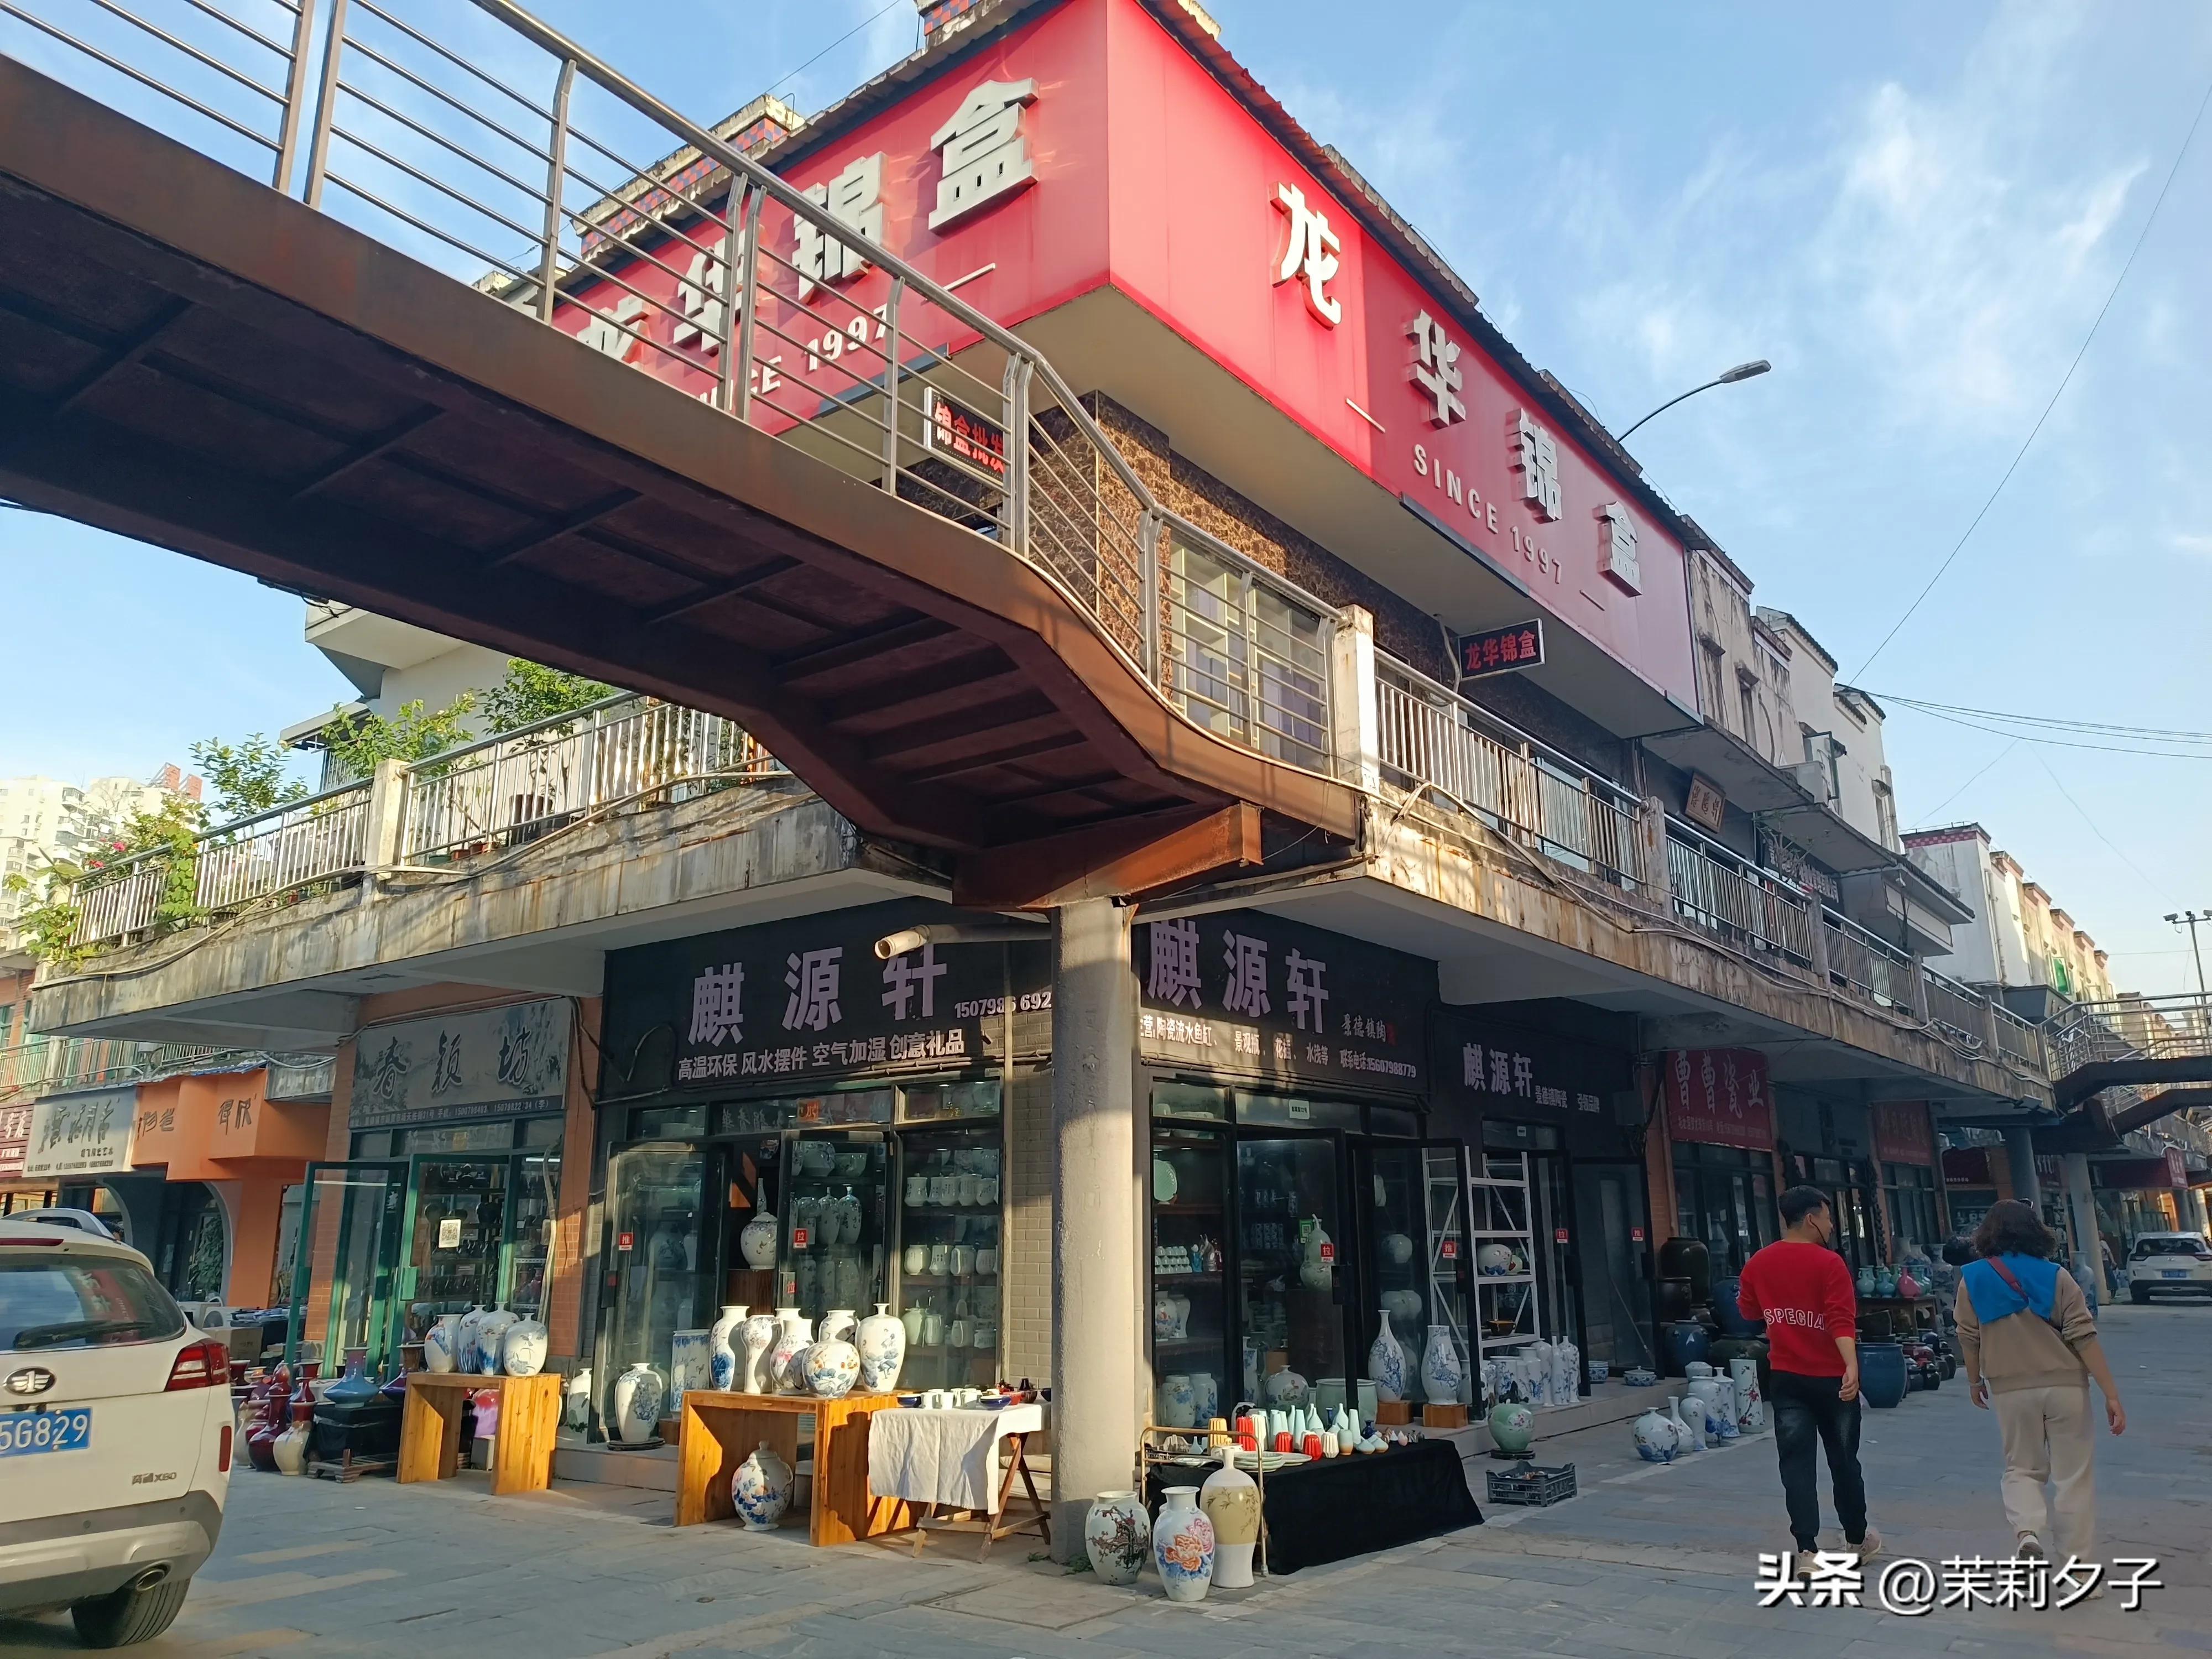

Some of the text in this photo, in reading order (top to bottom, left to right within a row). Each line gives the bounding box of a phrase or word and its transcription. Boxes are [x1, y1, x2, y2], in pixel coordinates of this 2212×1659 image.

[1270, 181, 1644, 597] 龙华锦盒
[1413, 444, 1563, 585] SINCE 1997
[1464, 629, 1537, 670] 龙华锦盒
[688, 942, 948, 1046] 麒源轩
[1146, 919, 1329, 1034] 麒源轩
[678, 1029, 965, 1081] 高温环保 风水摆件 空气加湿 创意礼品
[1463, 1042, 1533, 1098] 麒源轩
[797, 1232, 805, 1241] 拉
[1323, 1246, 1331, 1255] 拉
